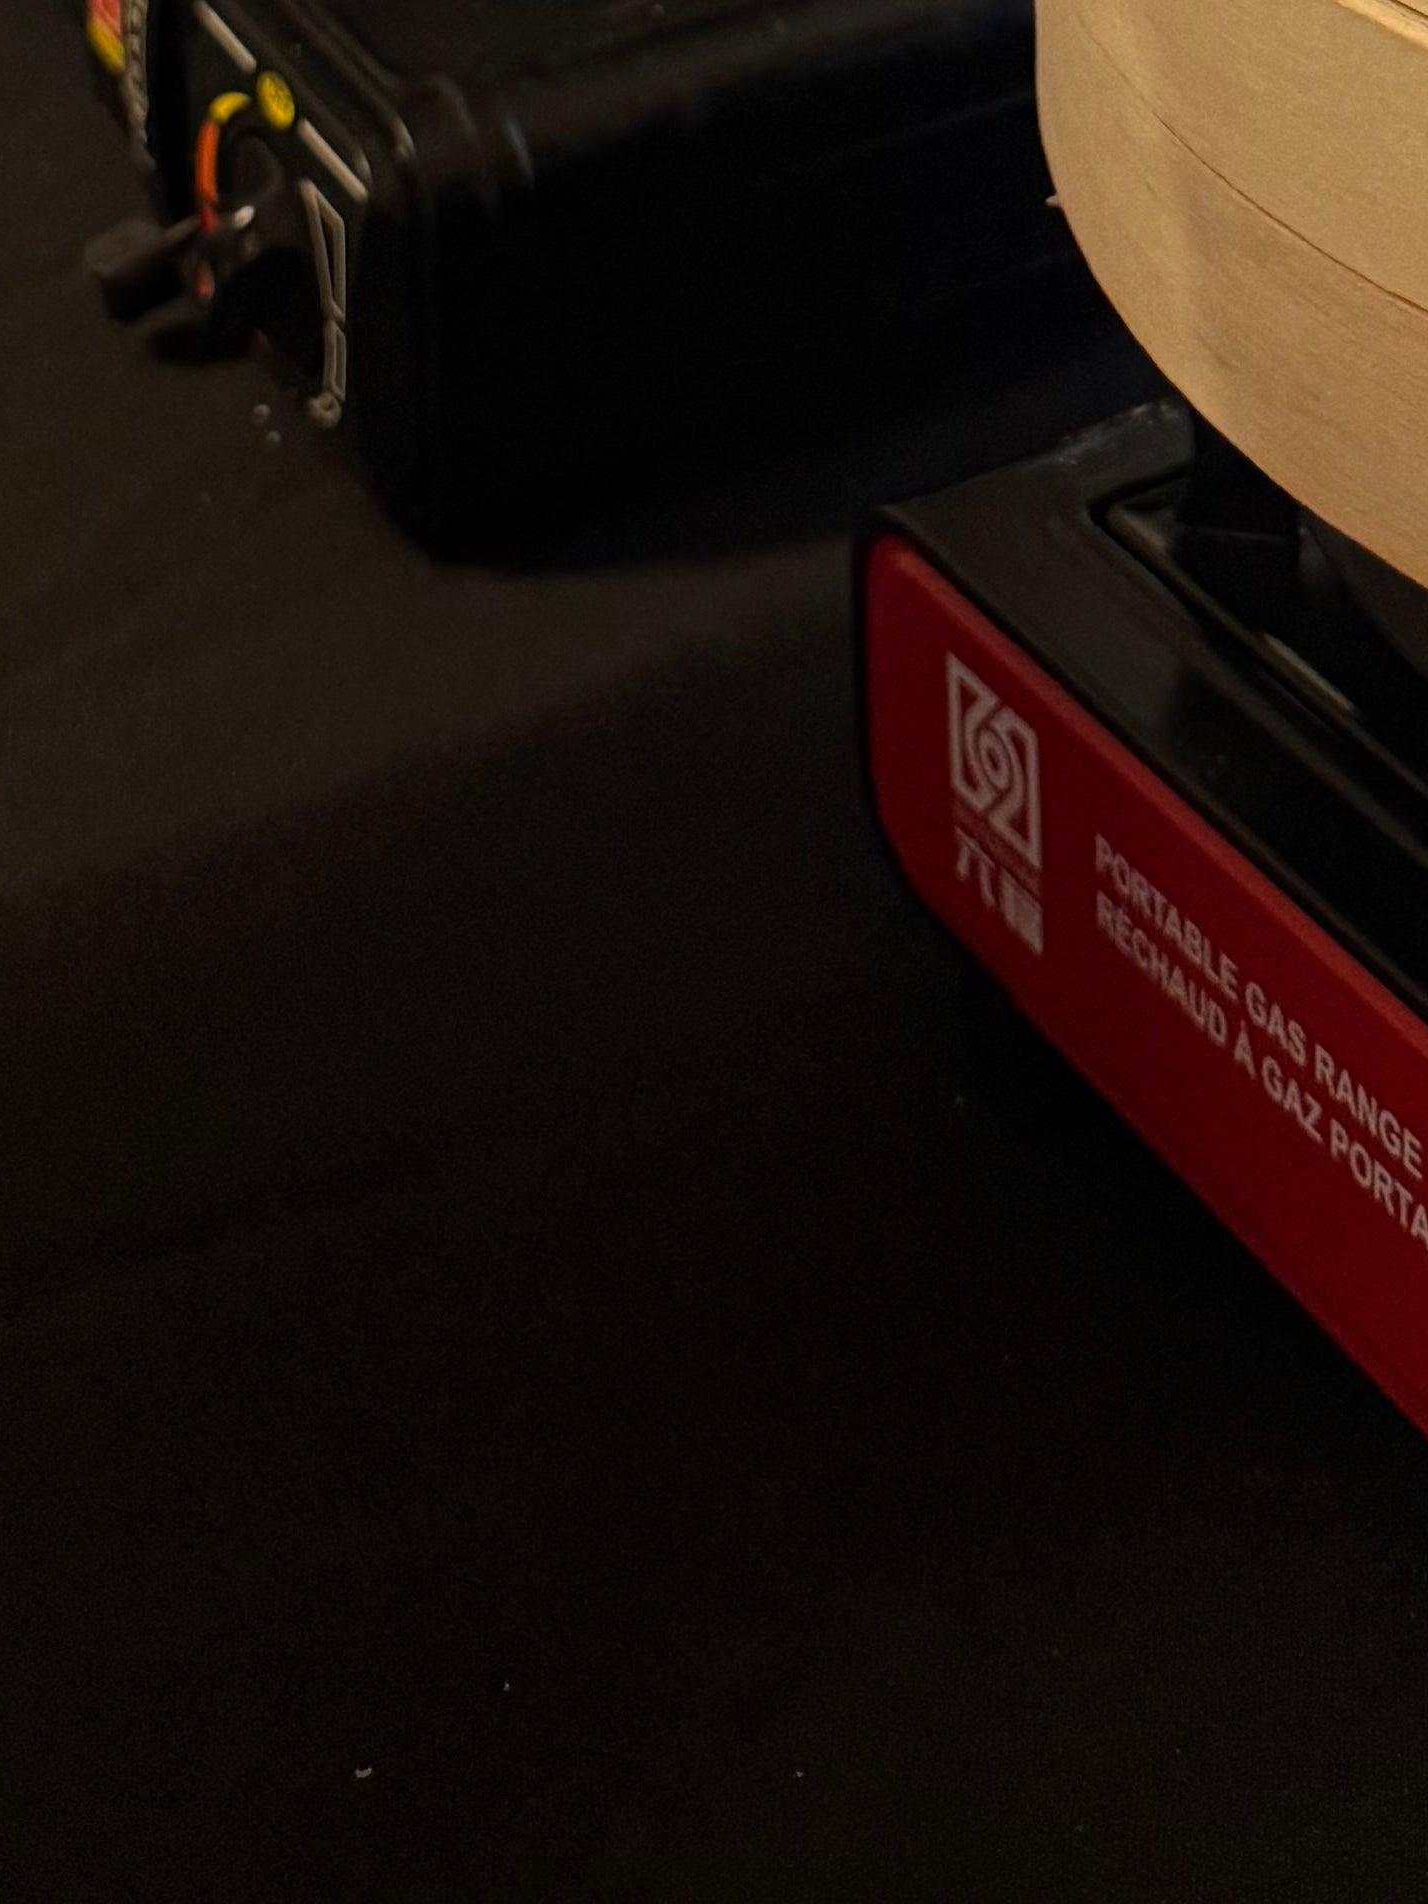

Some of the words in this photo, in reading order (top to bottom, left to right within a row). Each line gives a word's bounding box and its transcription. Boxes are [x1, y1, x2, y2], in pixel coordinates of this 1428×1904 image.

[1095, 831, 1239, 1002] PORTABLE
[1245, 982, 1308, 1066] GAS
[1314, 1043, 1424, 1181] RANGE
[1261, 1057, 1322, 1144] GAZ
